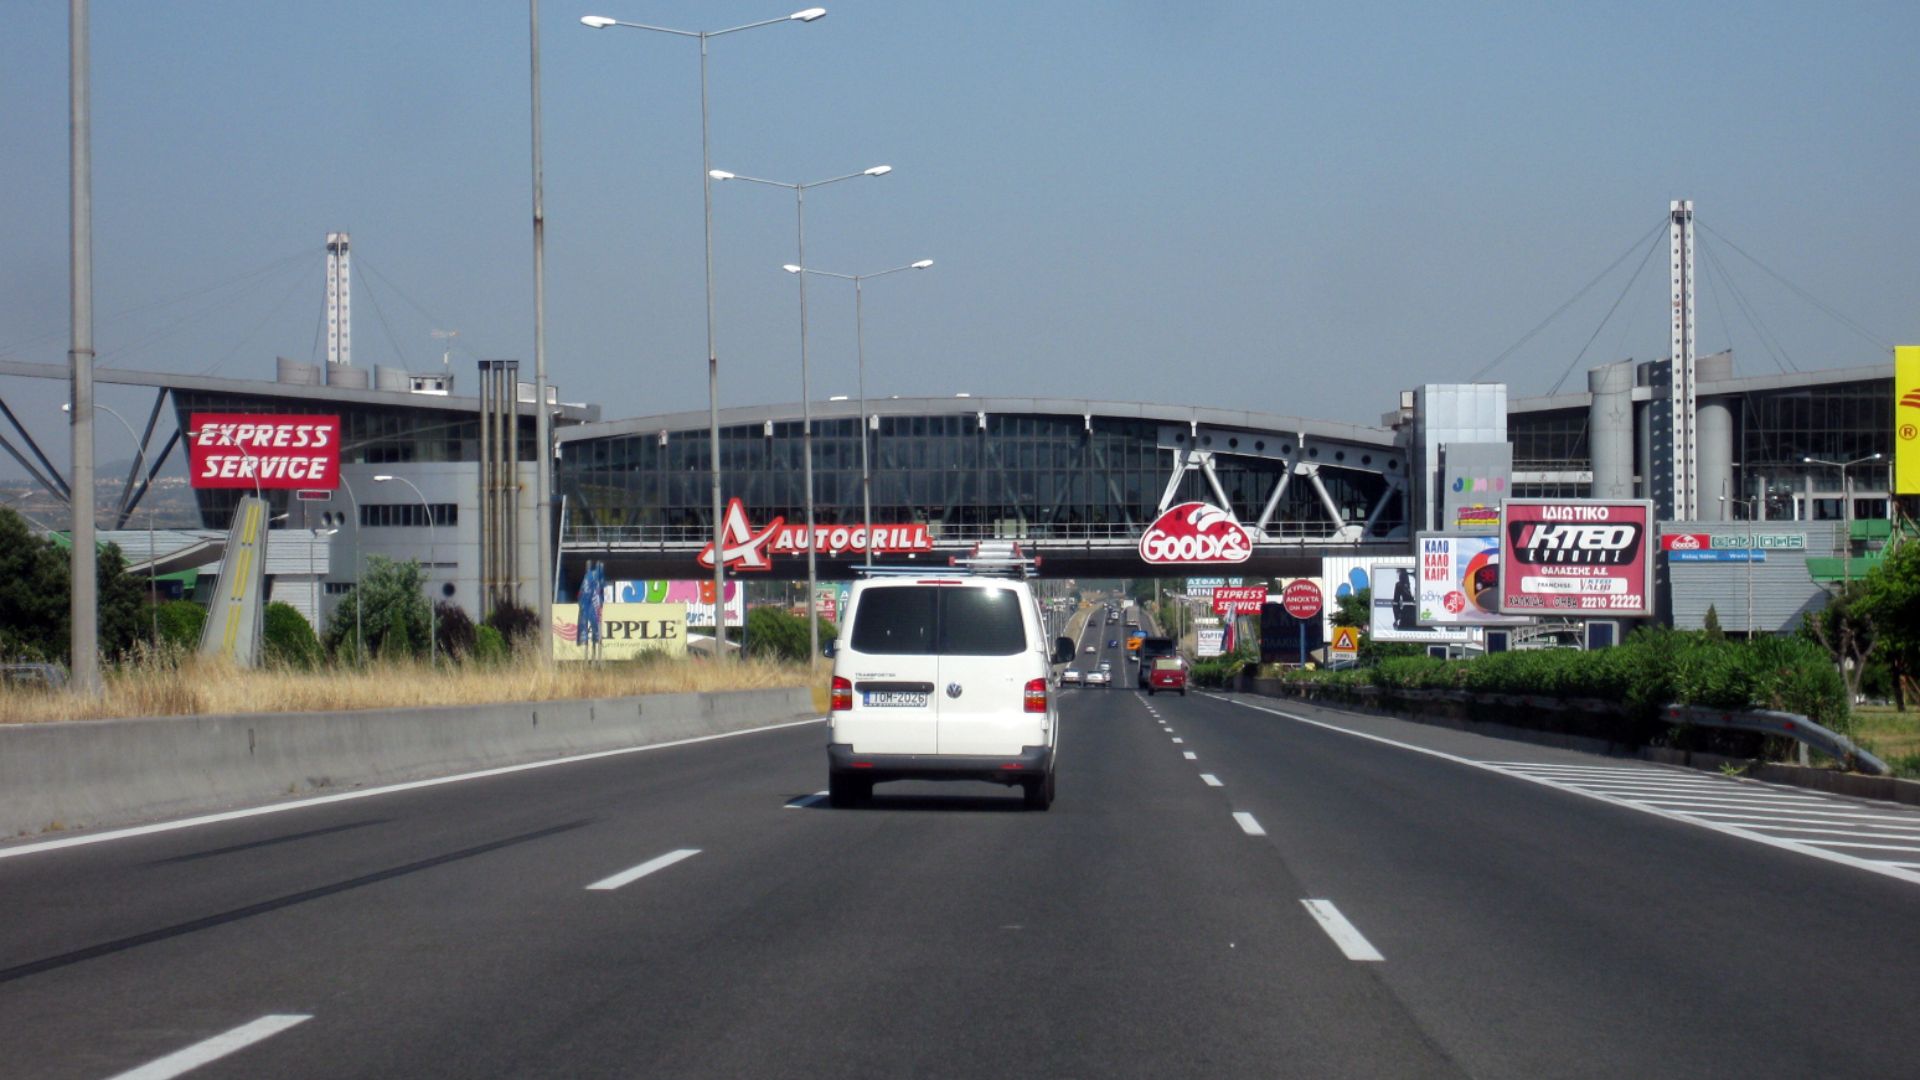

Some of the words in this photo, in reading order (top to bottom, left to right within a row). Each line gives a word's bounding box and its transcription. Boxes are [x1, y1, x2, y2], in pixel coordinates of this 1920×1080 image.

[197, 423, 333, 448] EXPRESS
[201, 455, 328, 480] SERVICE
[1542, 505, 1609, 520] ΙΔΙΩΤΙΚΟ
[775, 527, 929, 550] AUTOGRILL
[1424, 540, 1449, 553] ΚΑΛΟ
[1424, 554, 1449, 567] ΚΑΛΟ
[1424, 567, 1449, 581] ΚΑΙΡΙ
[1541, 566, 1591, 576] ΘΑΛΑΣΣΗΣ
[1215, 589, 1264, 600] EXPRESS
[1581, 596, 1607, 608] 22210
[1609, 594, 1641, 609] 22222
